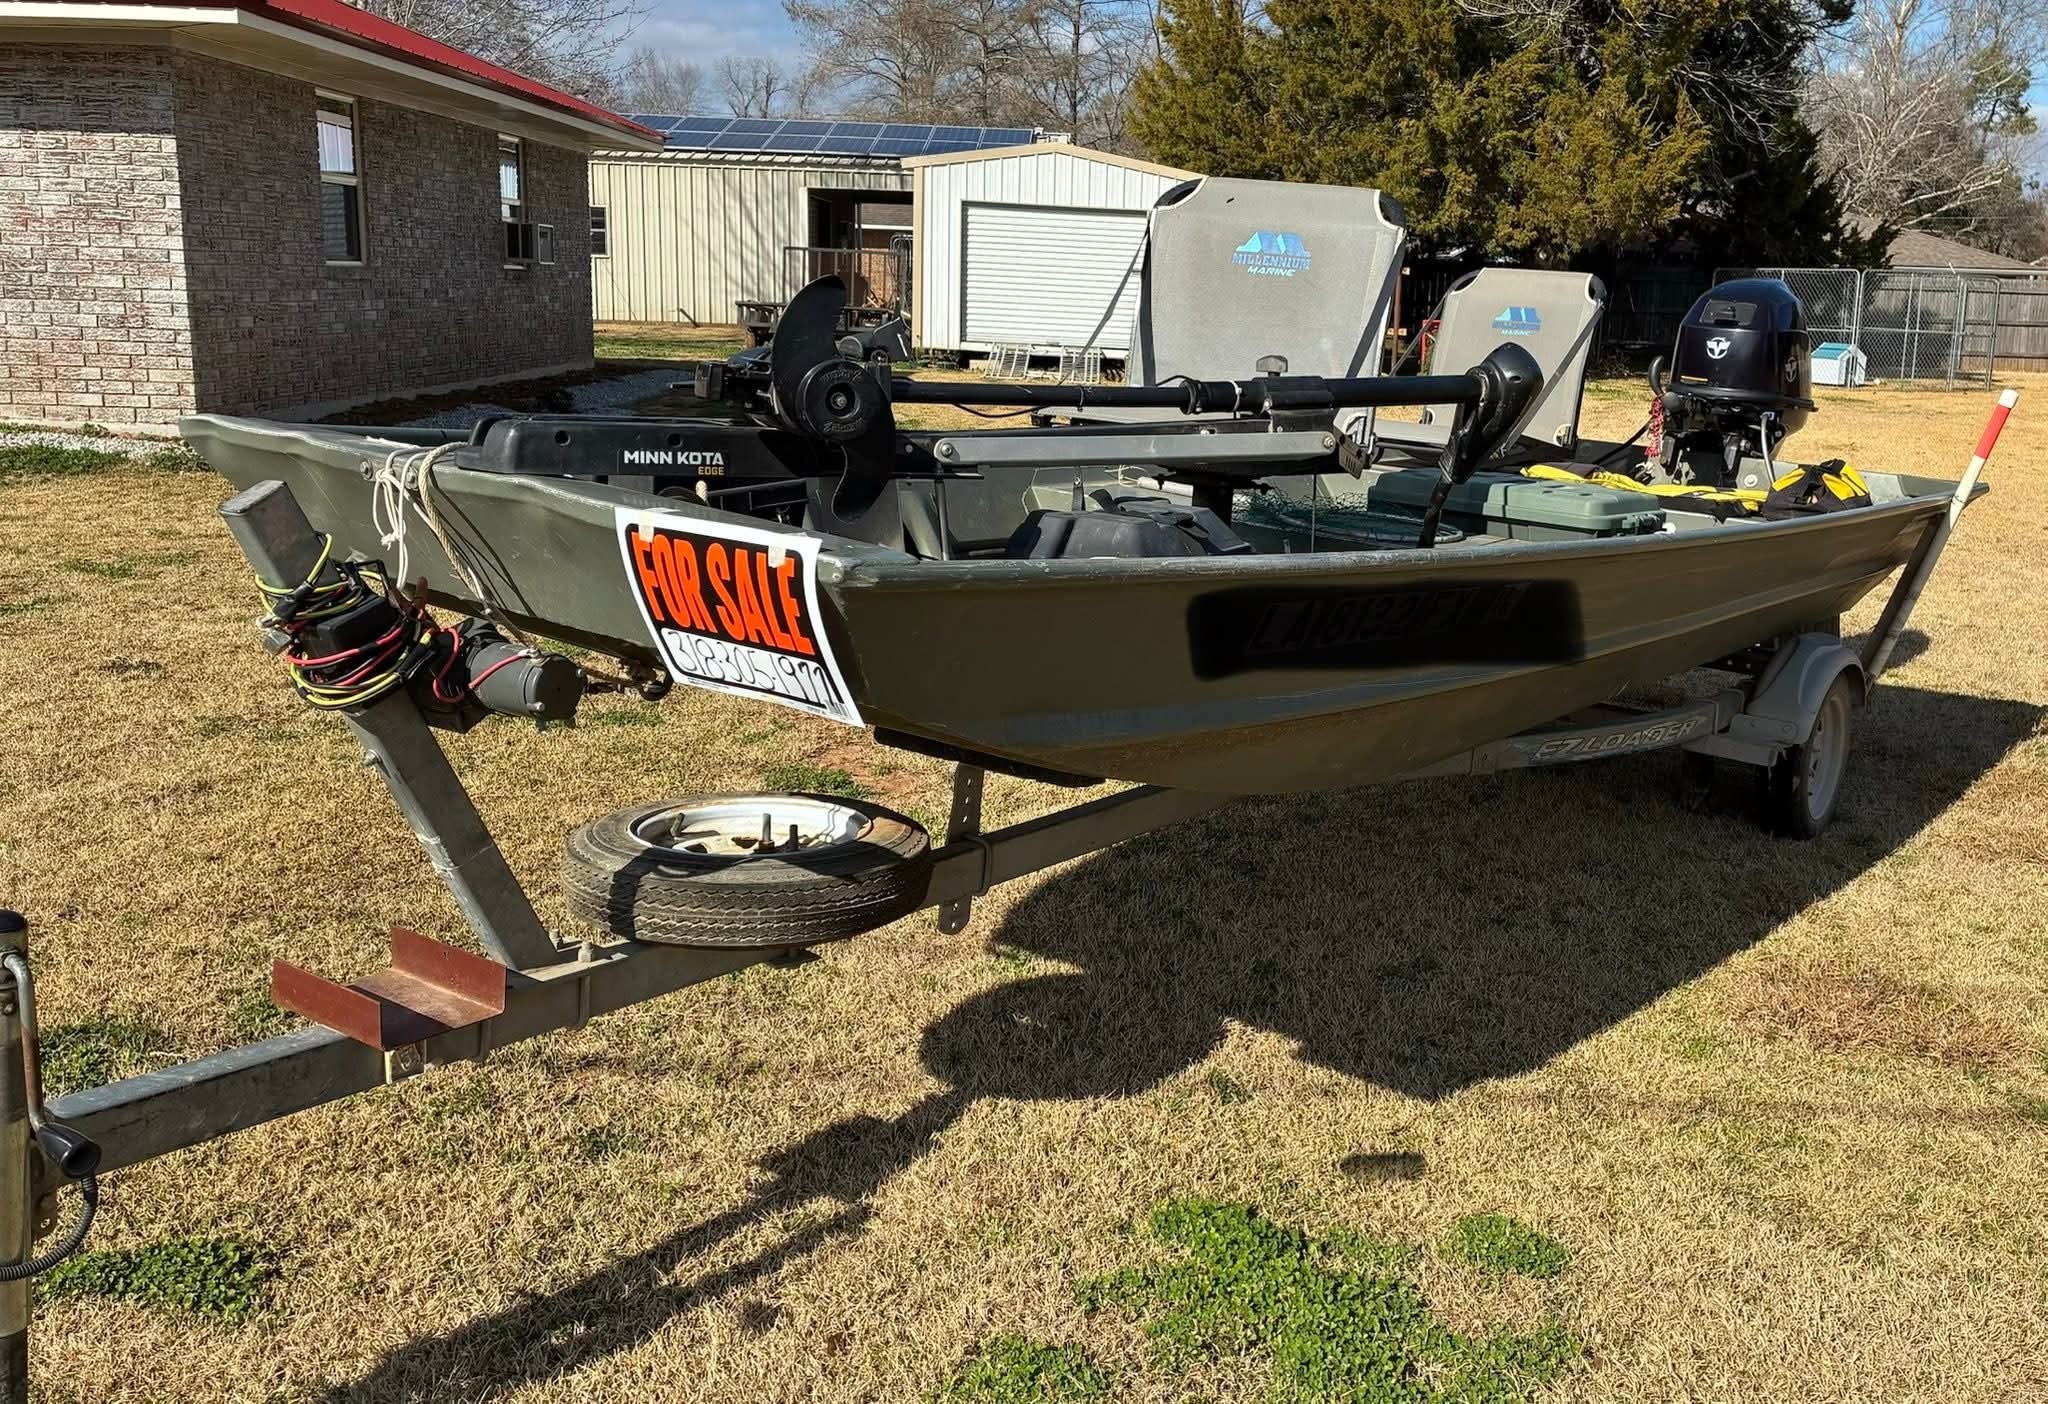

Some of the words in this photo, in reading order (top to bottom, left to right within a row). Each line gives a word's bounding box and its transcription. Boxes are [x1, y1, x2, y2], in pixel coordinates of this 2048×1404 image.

[1232, 252, 1311, 270] MILLENNIUM
[1247, 265, 1296, 277] MARINE
[623, 450, 673, 464] MINN
[677, 451, 724, 465] KOTA
[698, 466, 725, 475] EDGE
[631, 531, 718, 633] FOR
[706, 543, 815, 656] SALE
